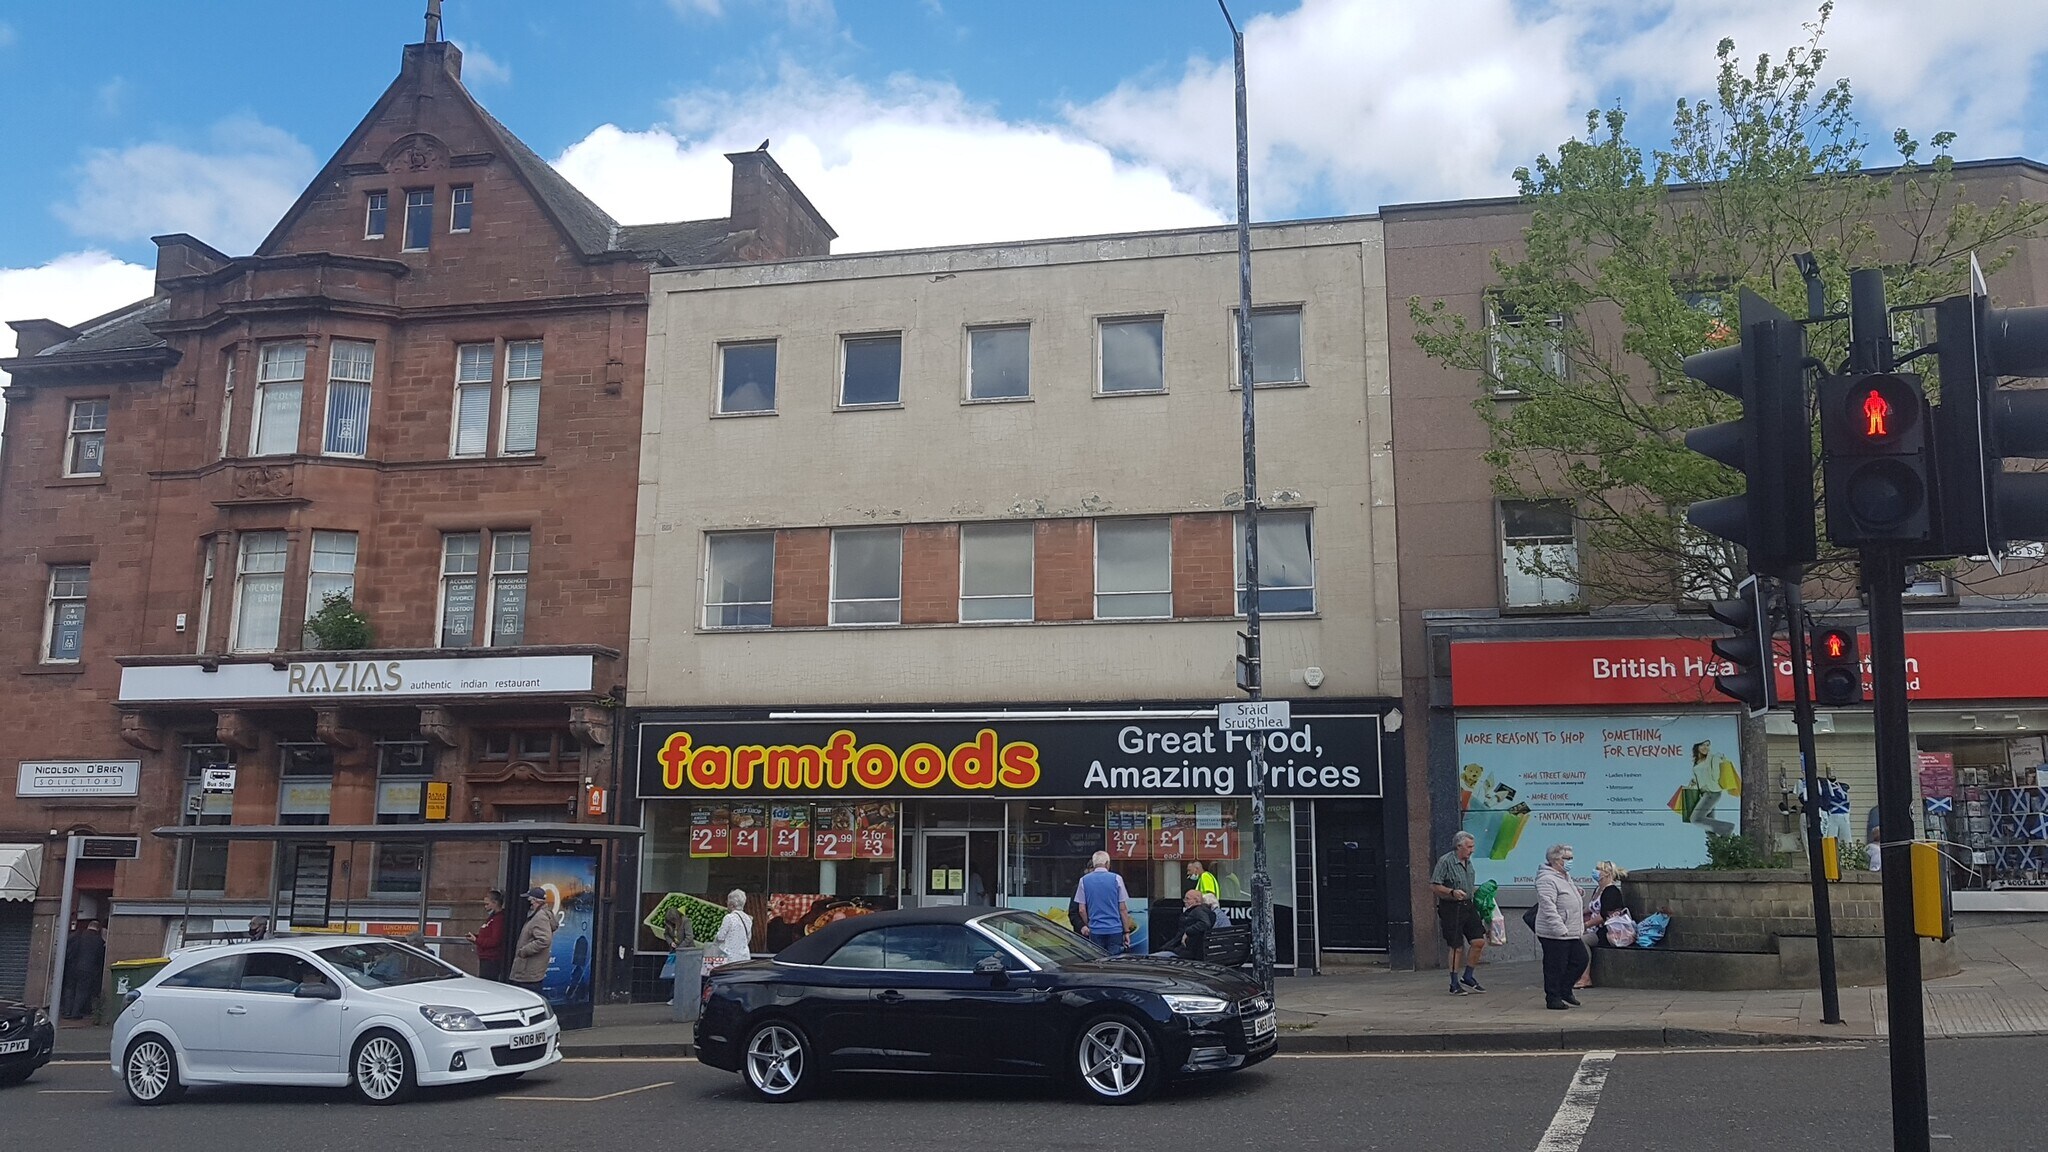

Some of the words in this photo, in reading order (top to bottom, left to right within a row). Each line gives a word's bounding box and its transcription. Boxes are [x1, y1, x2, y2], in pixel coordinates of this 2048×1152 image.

[1592, 657, 1677, 679] British
[288, 661, 402, 693] RAZIAS
[410, 681, 451, 690] authentic
[460, 680, 487, 689] indian
[495, 678, 540, 688] restaurant
[1237, 704, 1268, 716] Sràid
[1224, 717, 1283, 729] Sruighlea
[1118, 725, 1216, 754] Great
[1464, 733, 1492, 745] MORE
[1496, 731, 1539, 745] REASONS
[1541, 731, 1557, 744] TO
[1560, 731, 1585, 744] SHOP
[1602, 728, 1662, 742] SOMETHING
[657, 728, 1040, 790] farmfoods
[1603, 745, 1625, 759] FOR
[1627, 744, 1683, 758] EVERYONE
[35, 765, 80, 774] NICOLSON
[86, 765, 124, 774] O'BRIEN
[1539, 771, 1561, 779] STREET
[1562, 771, 1587, 779] QUALITY
[39, 777, 117, 786] SOLICITORS
[1084, 760, 1234, 795] Amazing
[773, 808, 790, 819] fab
[1572, 812, 1592, 820] VALUE
[692, 829, 727, 850] £2.99
[737, 829, 758, 853] £1
[777, 829, 800, 852] £1
[862, 830, 869, 840] 2
[871, 830, 886, 840] for
[1113, 831, 1120, 840] 2
[1123, 831, 1139, 840] for
[1160, 830, 1184, 855] £1
[817, 834, 852, 855] £2.99
[864, 840, 883, 856] £3
[1117, 841, 1137, 857] £7
[1204, 831, 1228, 856] £1
[10, 1041, 26, 1051] PYX
